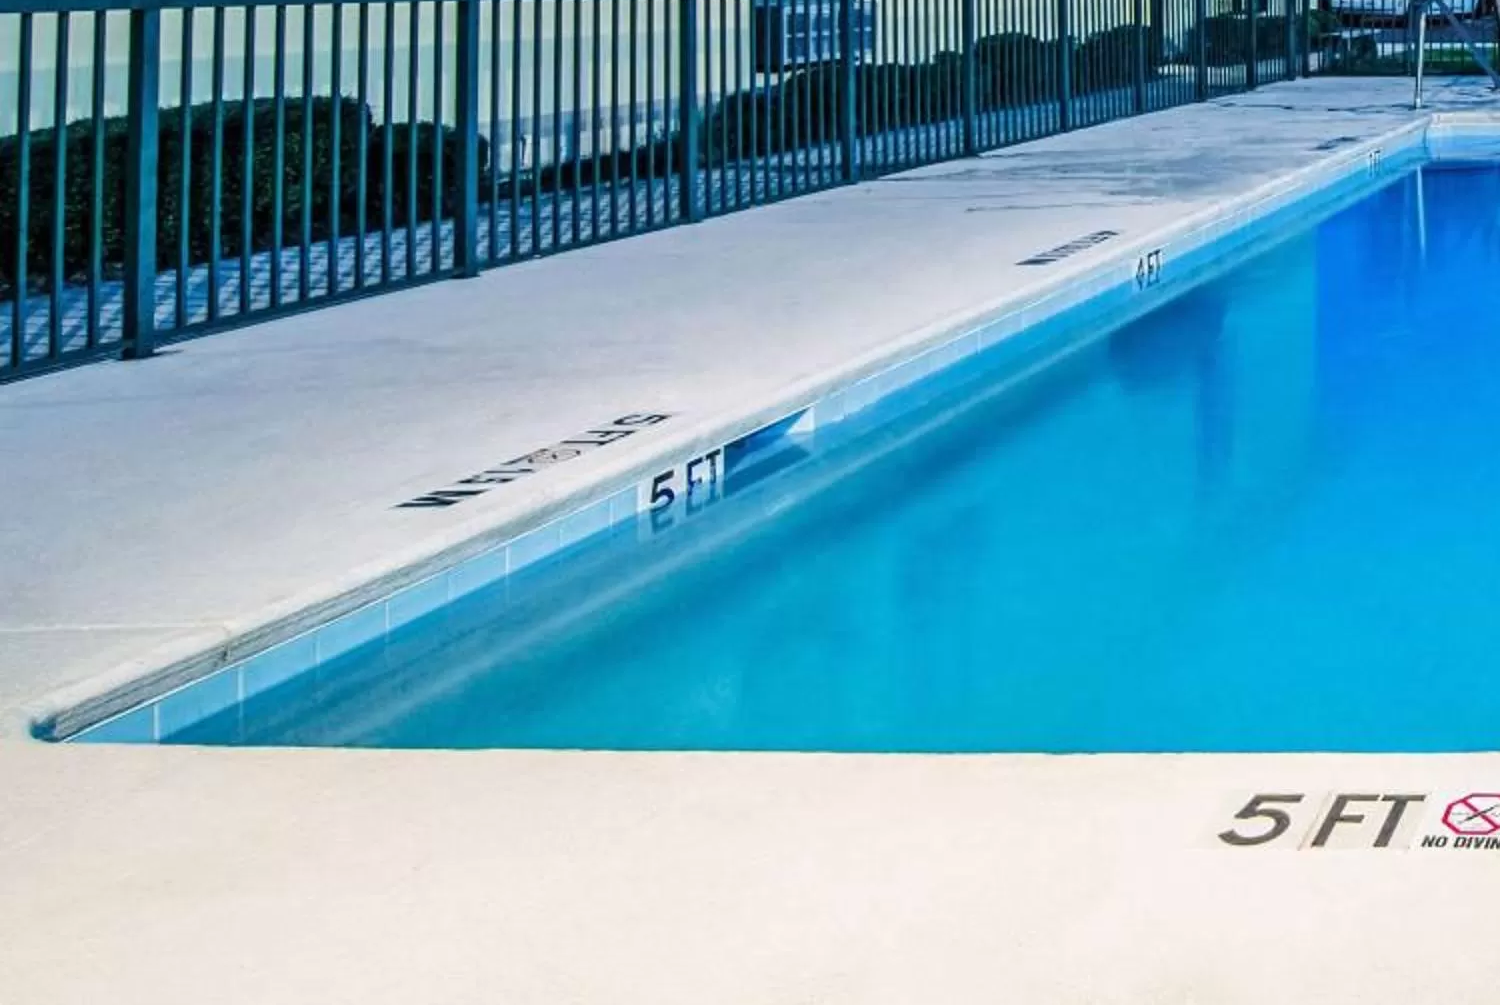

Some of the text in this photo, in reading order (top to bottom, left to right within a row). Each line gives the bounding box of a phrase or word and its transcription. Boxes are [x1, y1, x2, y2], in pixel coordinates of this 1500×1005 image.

[649, 448, 721, 513] 5 FT
[1216, 793, 1306, 847] 5
[1309, 793, 1427, 848] FT
[1420, 834, 1449, 848] NO
